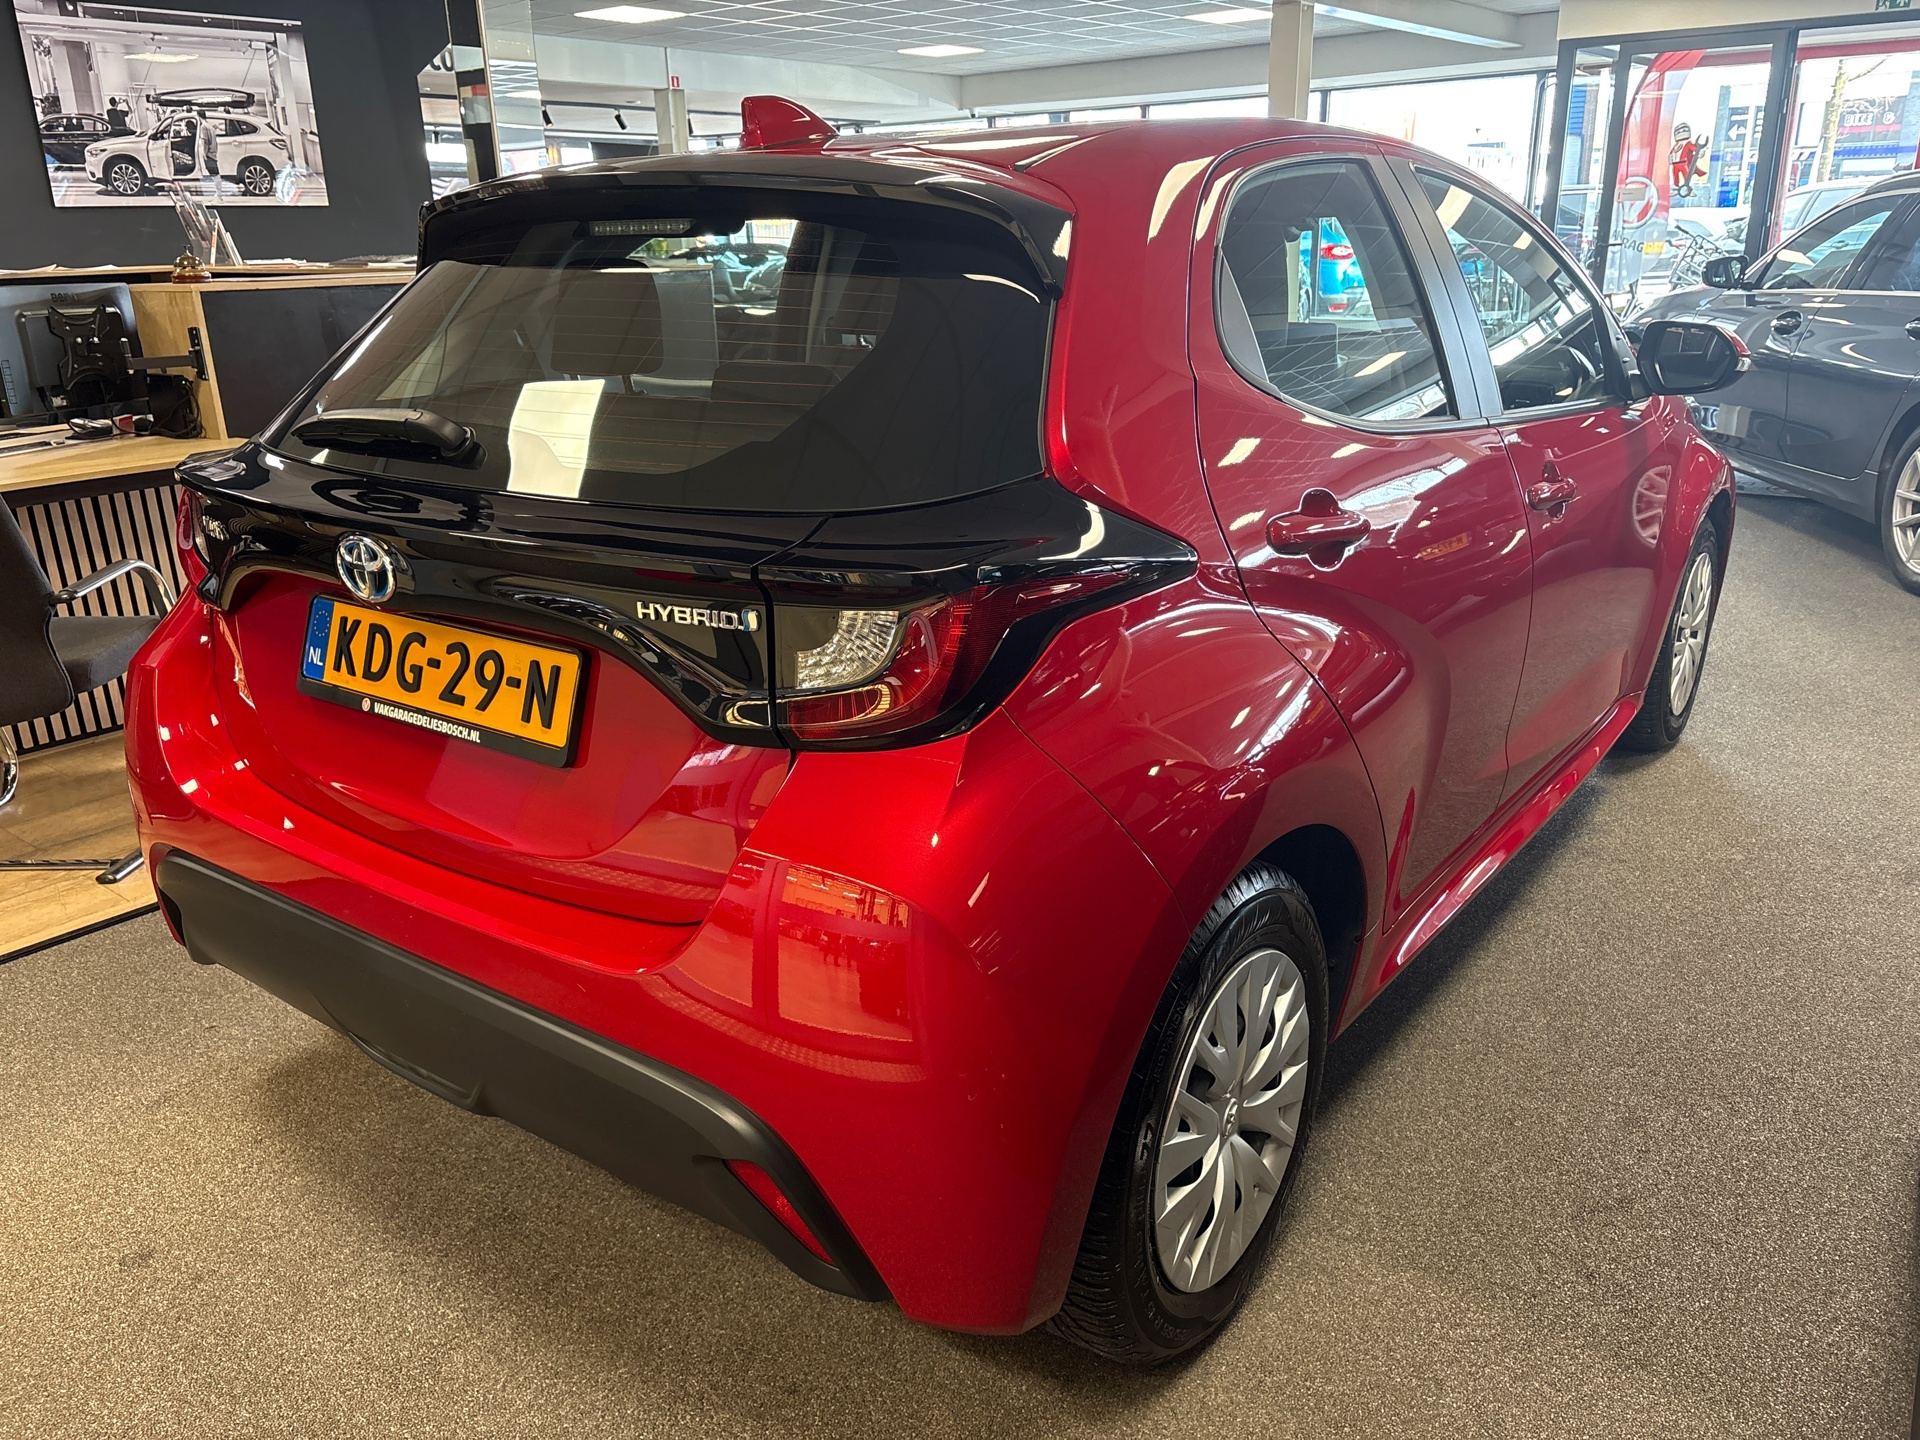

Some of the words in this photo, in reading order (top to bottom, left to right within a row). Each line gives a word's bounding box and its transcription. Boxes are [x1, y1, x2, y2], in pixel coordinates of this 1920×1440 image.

[636, 601, 739, 630] HYBRID
[308, 646, 323, 666] NL
[333, 615, 562, 730] KDG-29-N
[374, 701, 481, 743] VAKGARAGEDELIESBOSCH.NL
